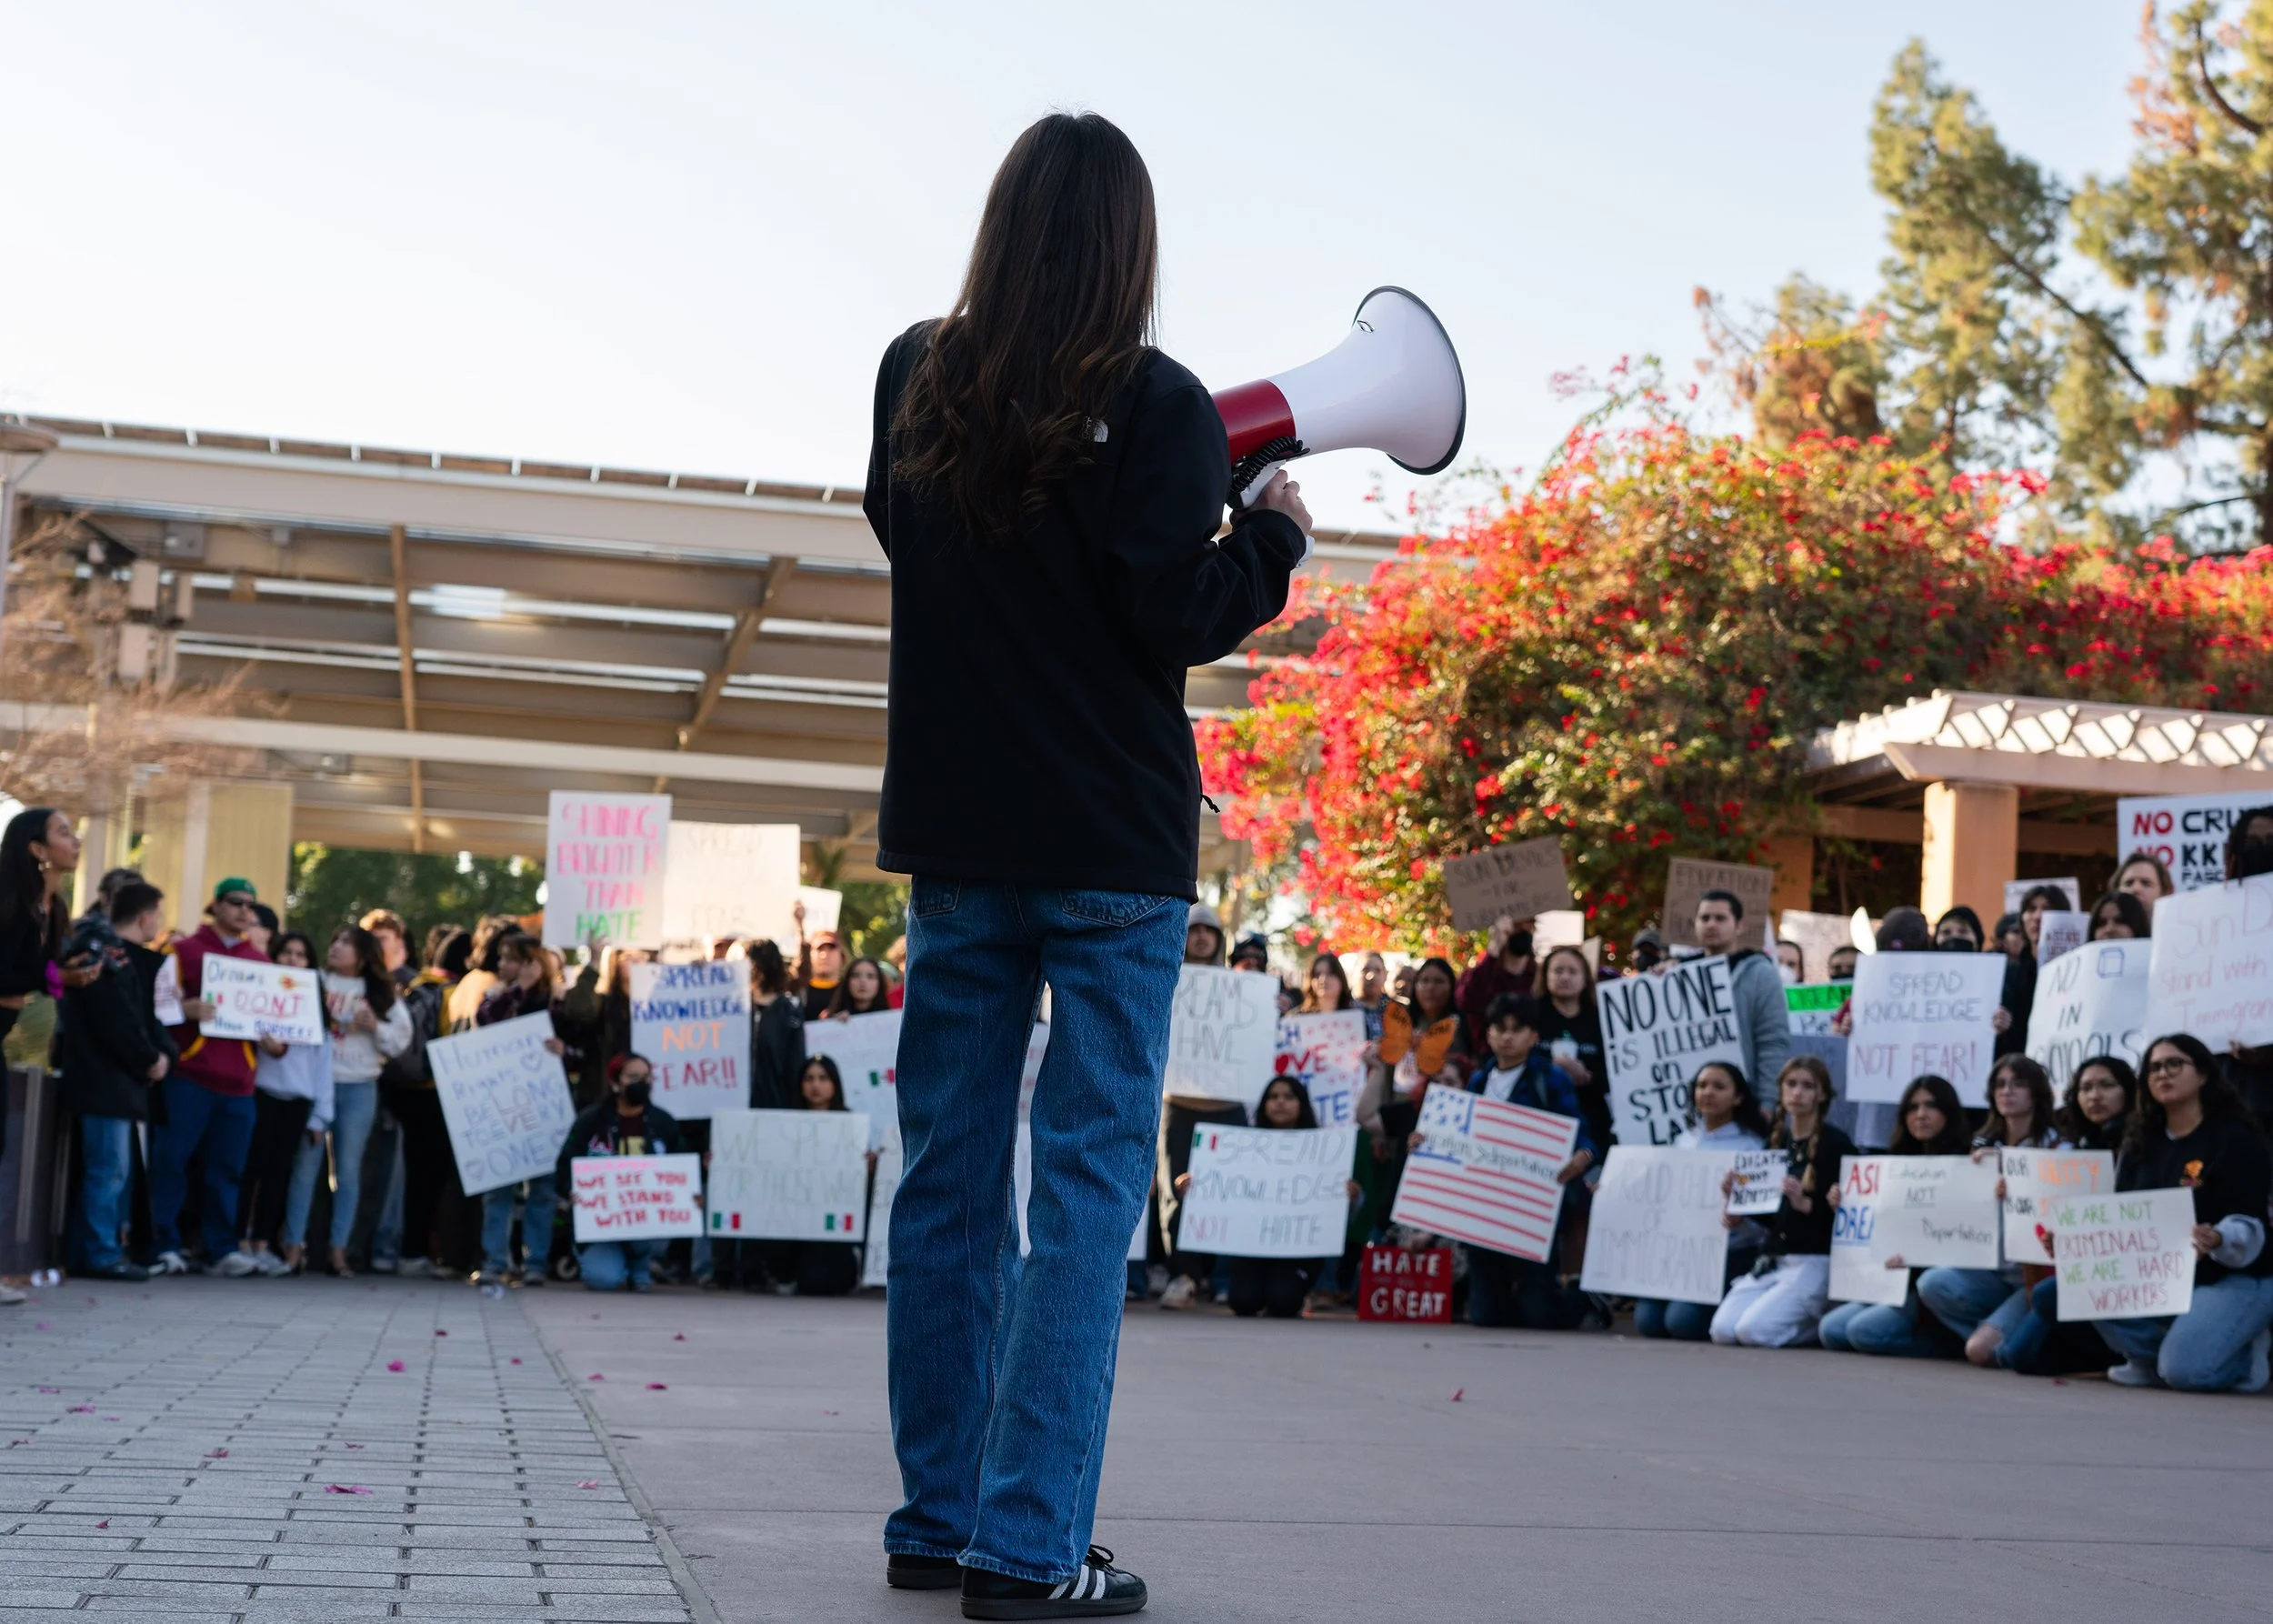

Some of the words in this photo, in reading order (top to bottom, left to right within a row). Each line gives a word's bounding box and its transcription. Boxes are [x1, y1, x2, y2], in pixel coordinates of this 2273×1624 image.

[2133, 808, 2174, 837] NO
[575, 911, 644, 942] HATE
[1173, 968, 1259, 1029] REAMS
[1888, 970, 1963, 998] SPREAD
[1603, 978, 1657, 1040] NO
[1662, 960, 1731, 1023] ONE
[1863, 998, 1982, 1026] KNOWLEDGE
[2058, 1001, 2082, 1031] IN
[661, 1020, 725, 1052] NOT
[1177, 1018, 1247, 1065] HAVE
[1652, 1017, 1737, 1059] ILLEGAL
[1855, 1042, 1900, 1079] NOT
[486, 1133, 556, 1178] ONE
[1185, 1212, 1228, 1244] NOT
[2052, 1201, 2078, 1227] WE
[2081, 1202, 2110, 1225] ARE
[2118, 1199, 2154, 1221] NOT
[2057, 1227, 2160, 1260] CRIMINALS
[1371, 1250, 1441, 1278] HATE
[2061, 1261, 2086, 1286] WE
[2092, 1258, 2126, 1281] ARE
[1370, 1287, 1447, 1318] GREAT
[2088, 1282, 2168, 1312] WORKERS
